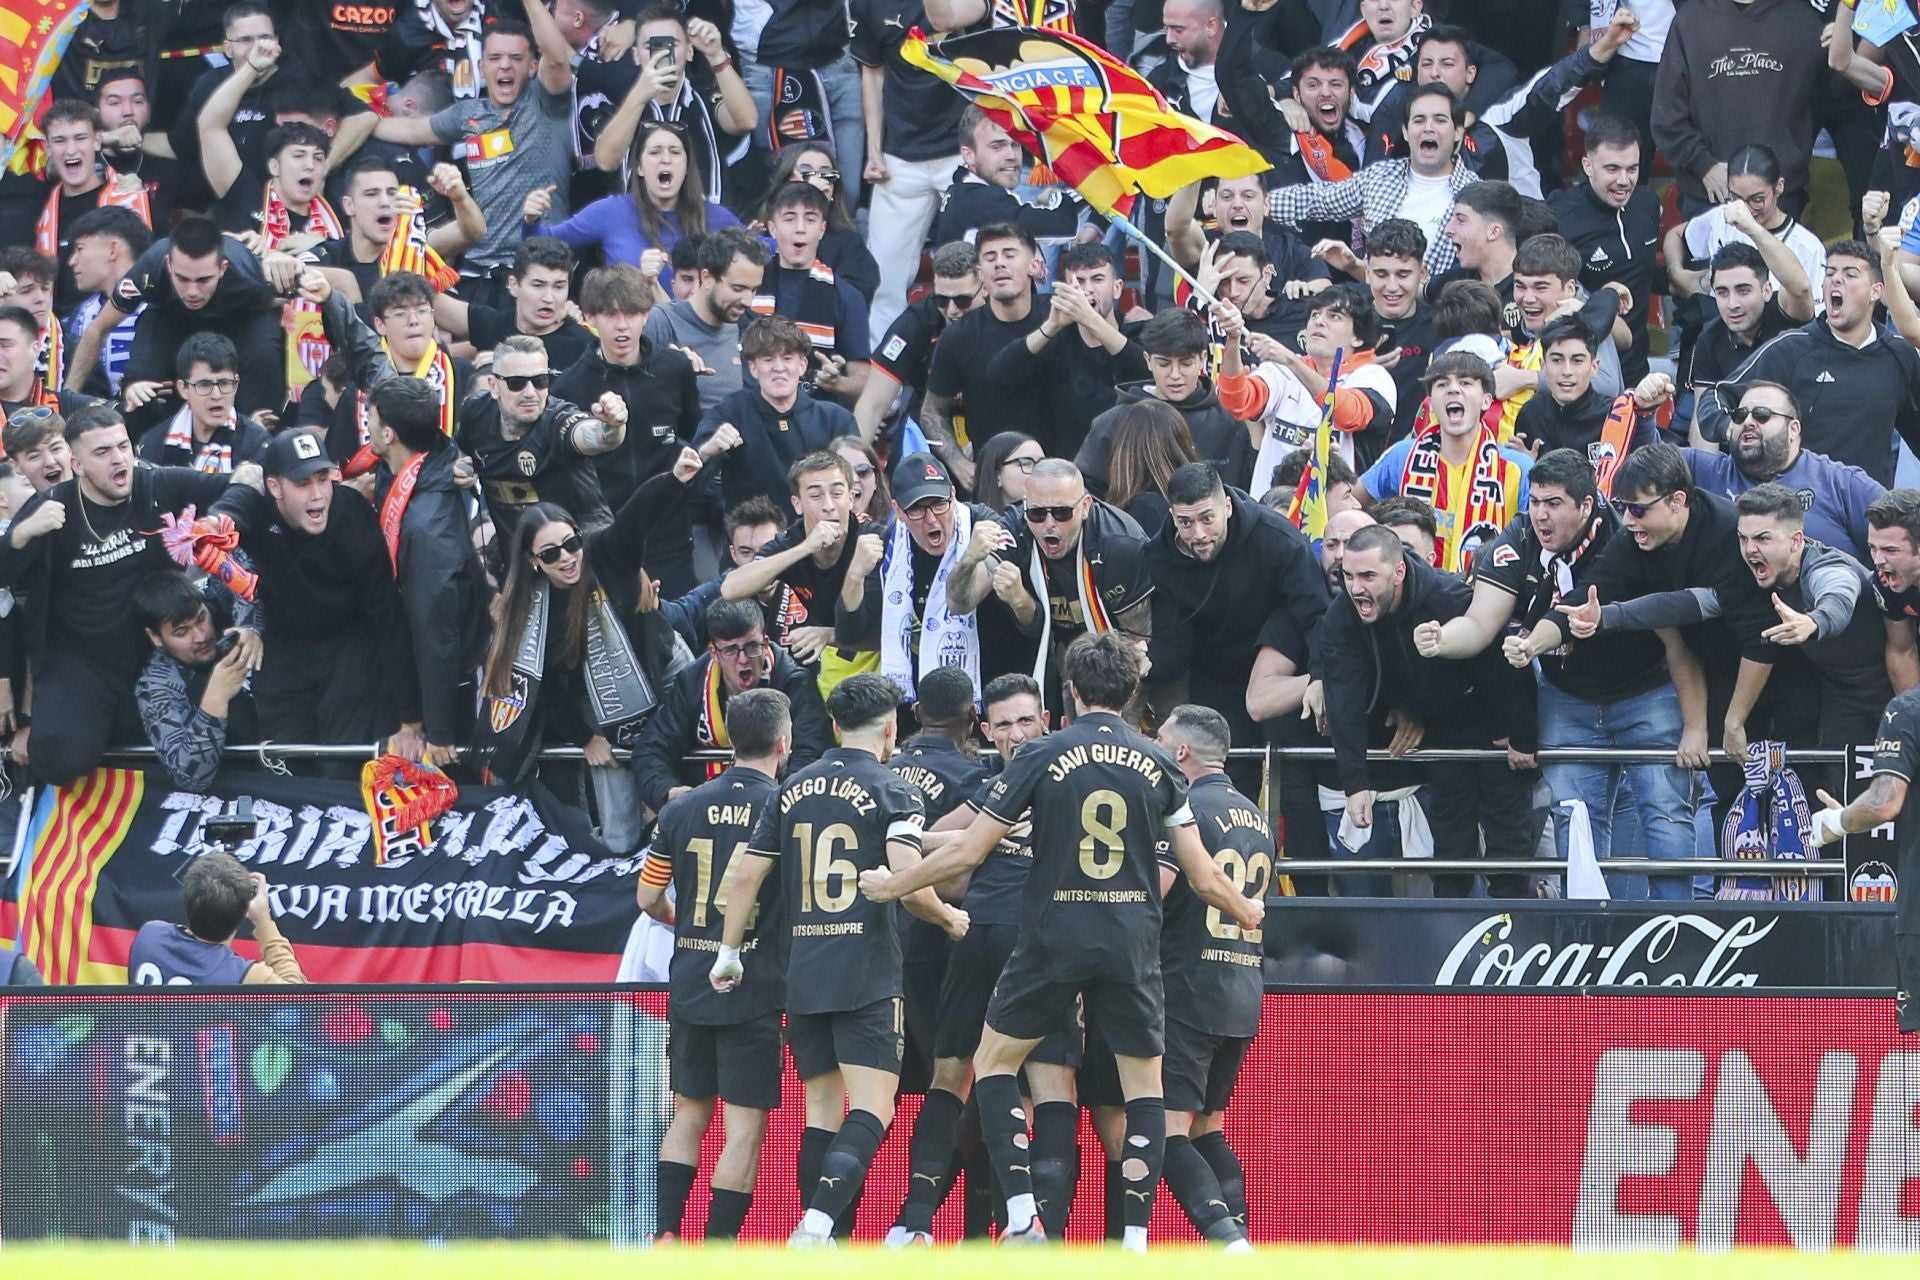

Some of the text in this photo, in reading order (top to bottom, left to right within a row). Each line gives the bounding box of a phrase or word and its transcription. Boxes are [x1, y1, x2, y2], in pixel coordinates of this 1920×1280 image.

[1708, 52, 1783, 79] The Place
[1047, 743, 1163, 789] JAVI GUERRA
[780, 776, 878, 817] DIEGO LÓPEZ
[1078, 789, 1129, 881] 8
[791, 822, 859, 914] 16
[1434, 914, 1780, 987] Coca-Cl
